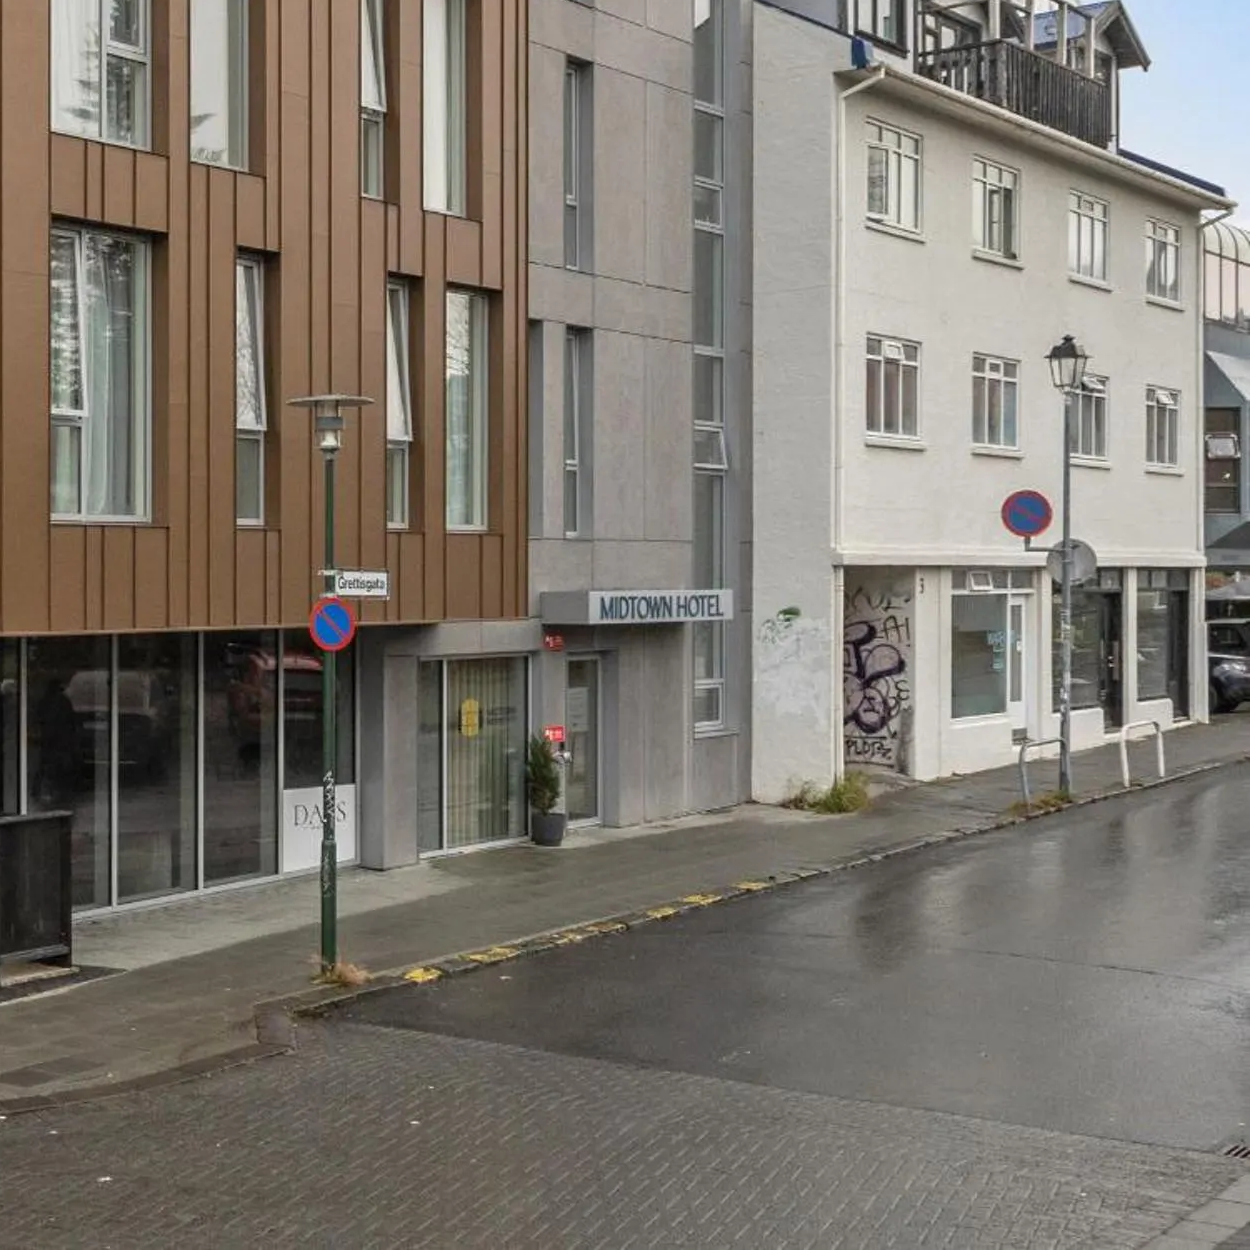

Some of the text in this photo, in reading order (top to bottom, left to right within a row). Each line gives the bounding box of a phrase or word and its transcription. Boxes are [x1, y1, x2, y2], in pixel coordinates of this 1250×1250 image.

[338, 576, 386, 593] Grettisgata
[599, 593, 724, 621] MIDTOWN HOTEL
[293, 800, 347, 827] DAS
